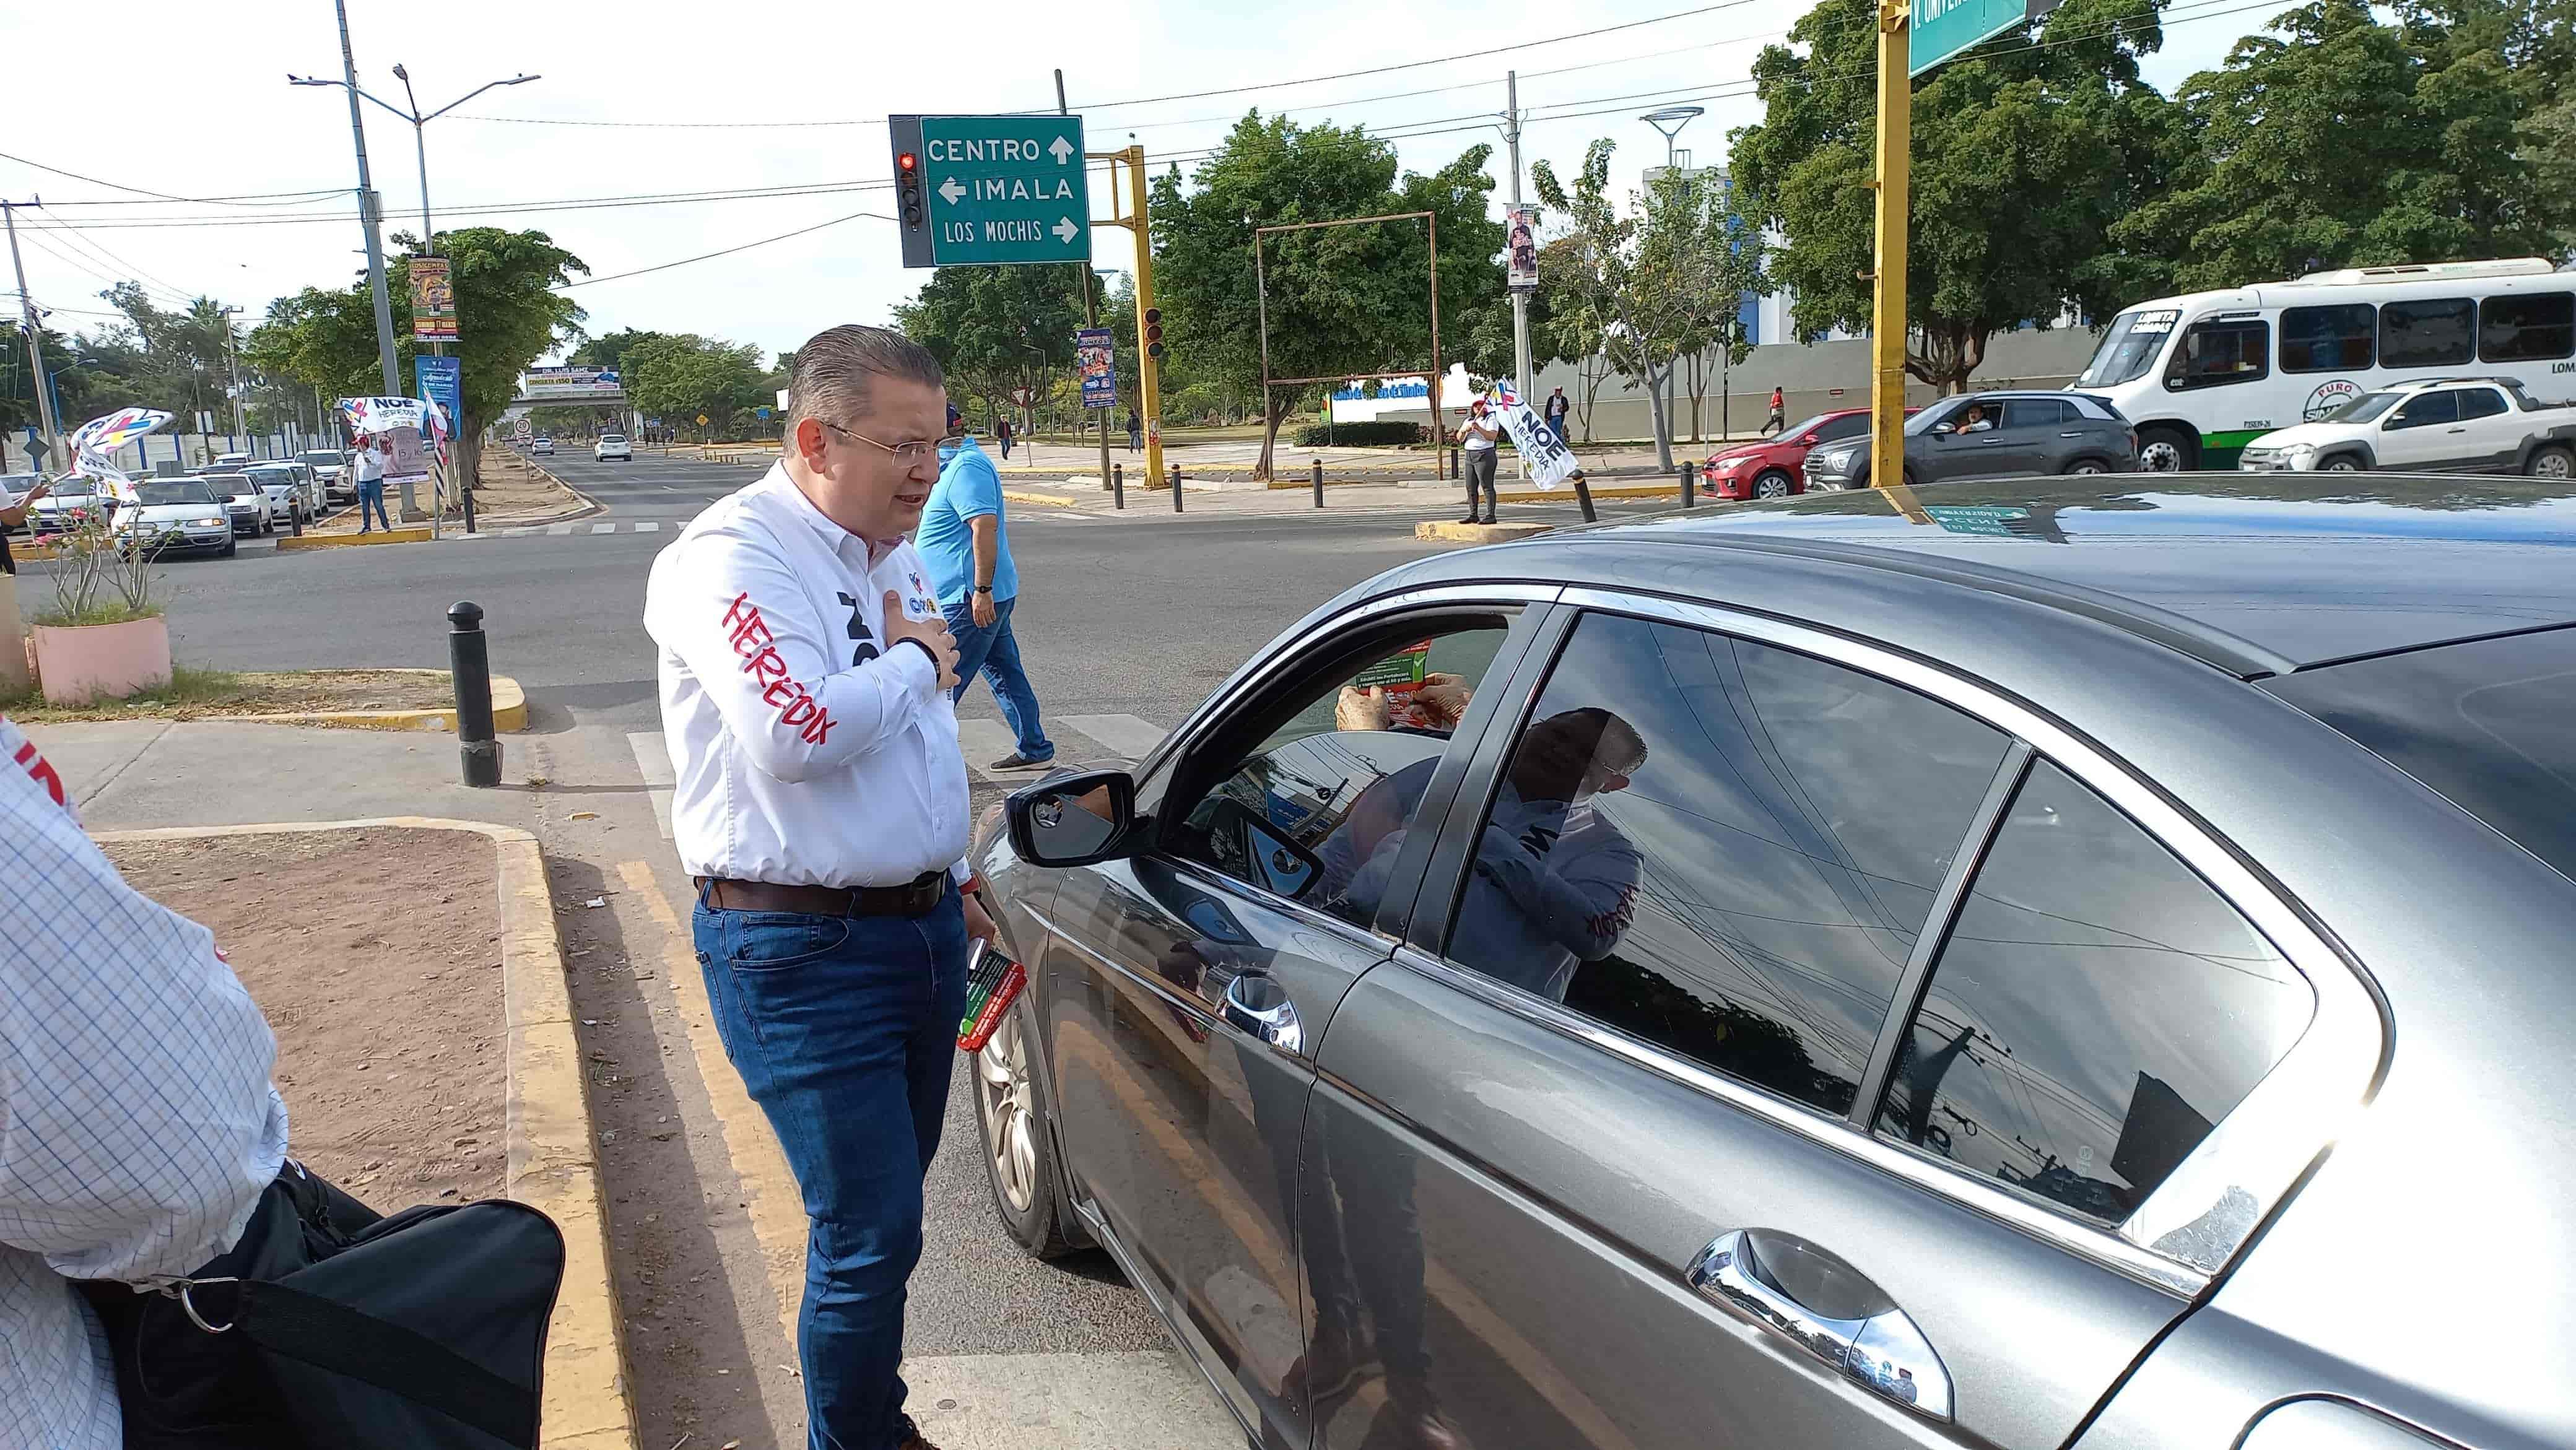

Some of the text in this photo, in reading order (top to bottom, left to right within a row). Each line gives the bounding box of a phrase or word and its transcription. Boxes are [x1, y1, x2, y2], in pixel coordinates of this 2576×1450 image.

[928, 139, 1040, 162] CENTRO
[975, 178, 1074, 201] IMALA
[944, 220, 1042, 243] LOS MOCHIS
[2552, 362, 2576, 374] LOM
[2318, 383, 2352, 397] PURO
[378, 409, 418, 419] HEREDIA
